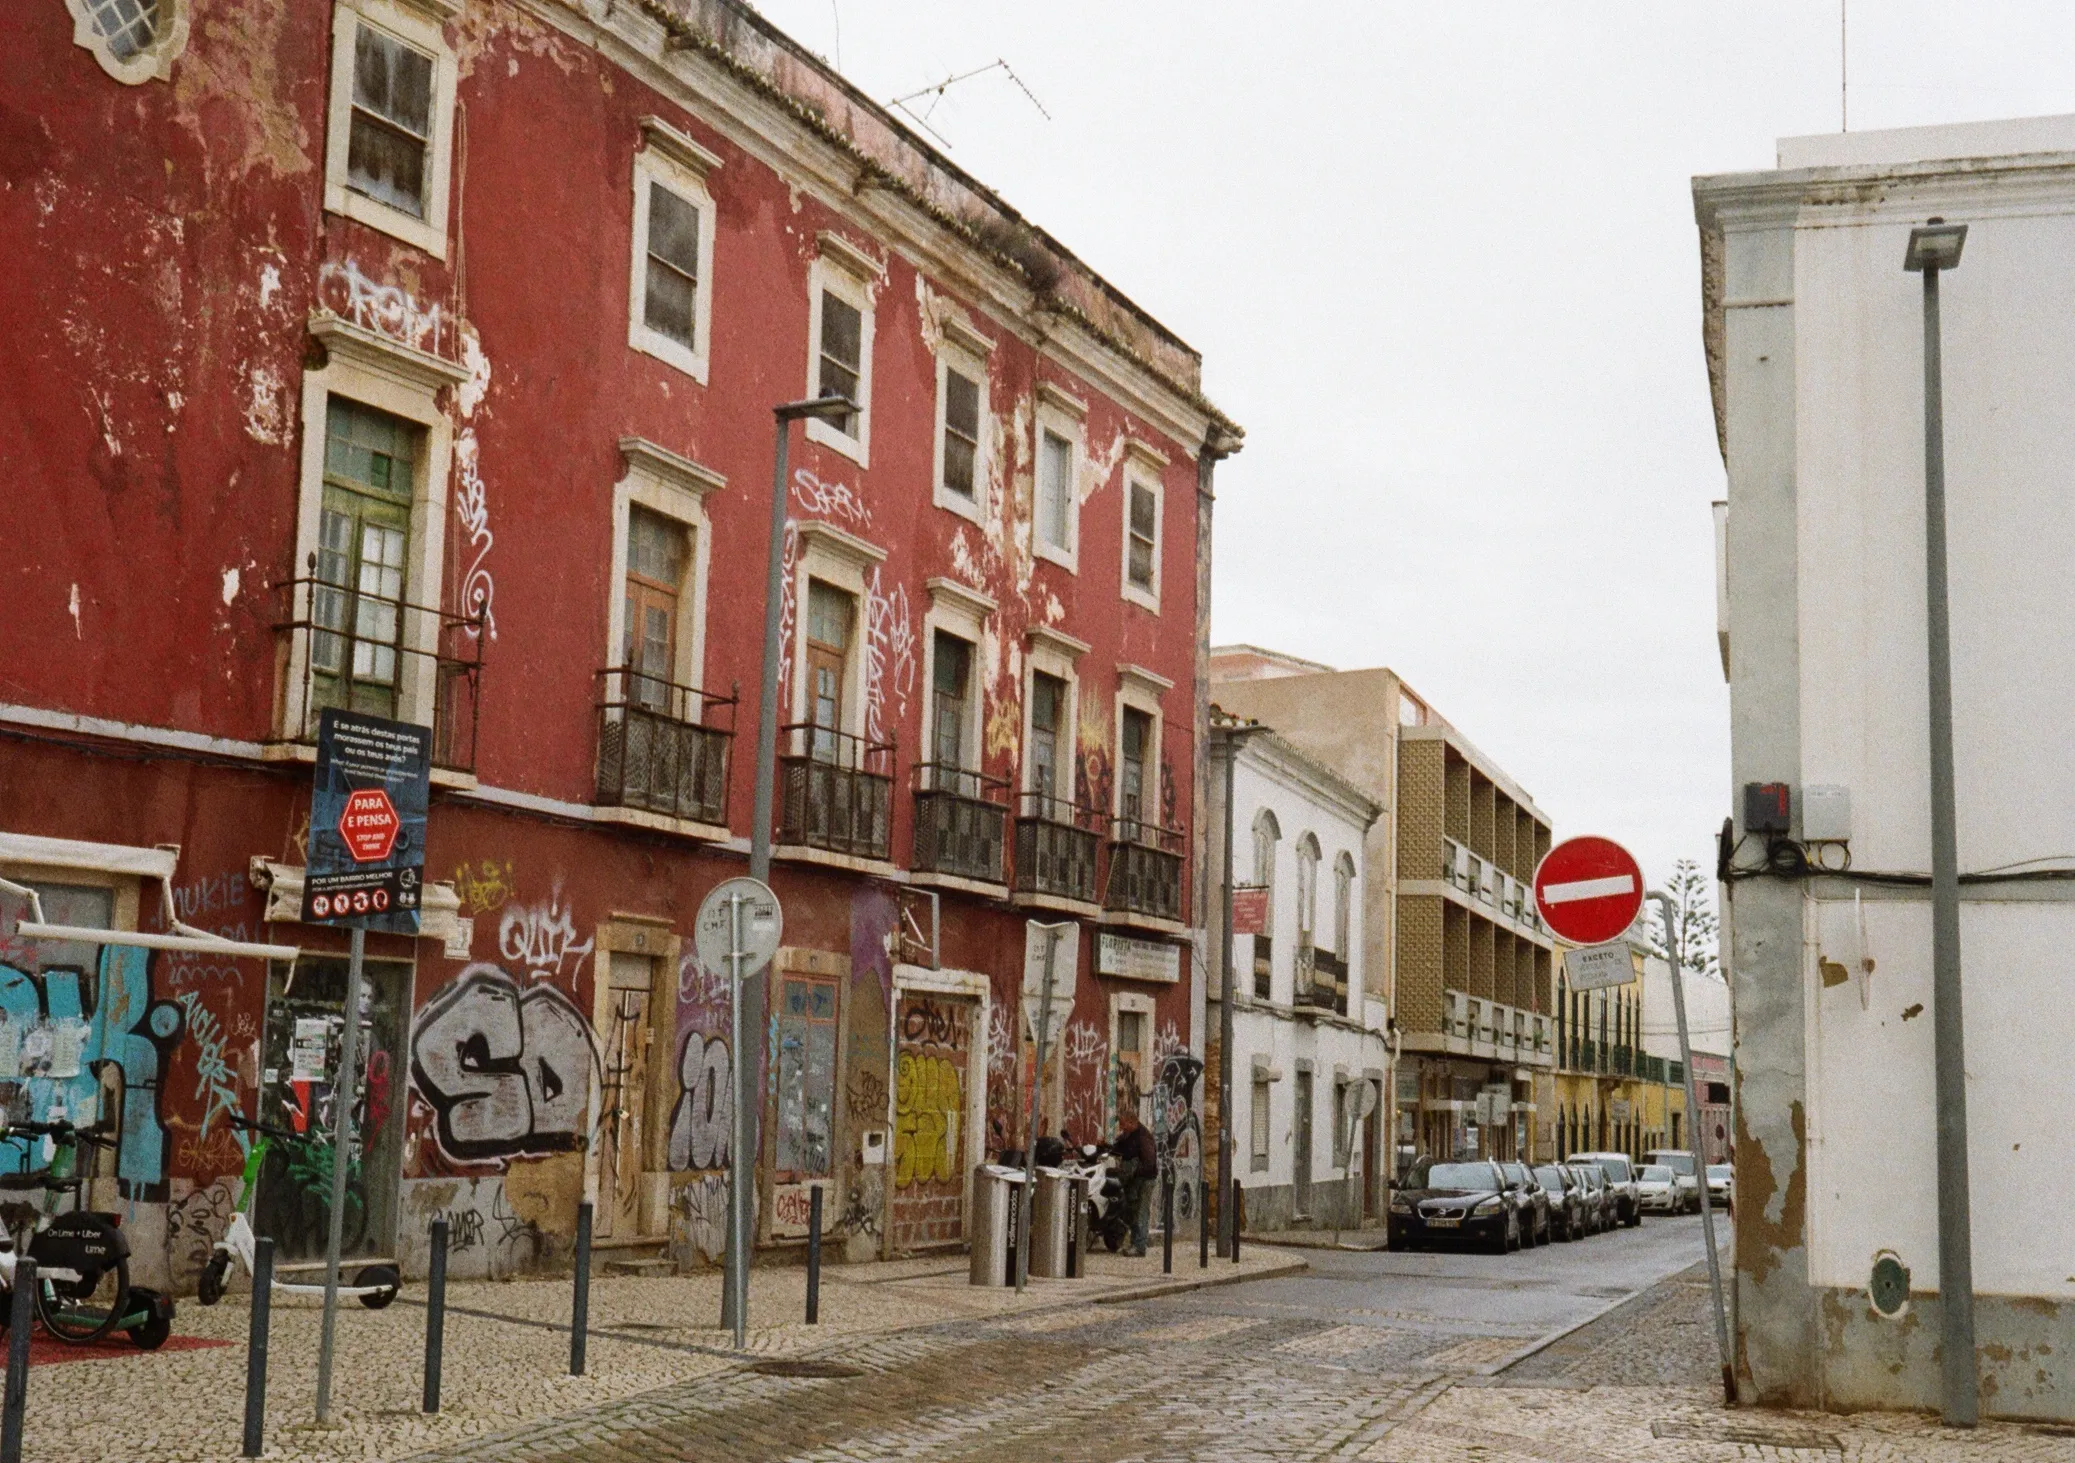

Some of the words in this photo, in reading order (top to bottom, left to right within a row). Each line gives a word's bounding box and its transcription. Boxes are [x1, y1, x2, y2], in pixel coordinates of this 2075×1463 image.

[333, 720, 339, 728] E
[350, 724, 370, 735] atrás
[371, 728, 396, 739] destas
[396, 734, 420, 744] portas
[334, 733, 374, 746] morassem
[385, 742, 402, 752] teus
[344, 747, 355, 755] ou
[367, 750, 384, 760] teus
[354, 798, 384, 811] PARA
[348, 816, 354, 828] E
[356, 814, 392, 827] PENSA
[340, 874, 365, 882] BAIRRO
[366, 871, 393, 880] MELHOR
